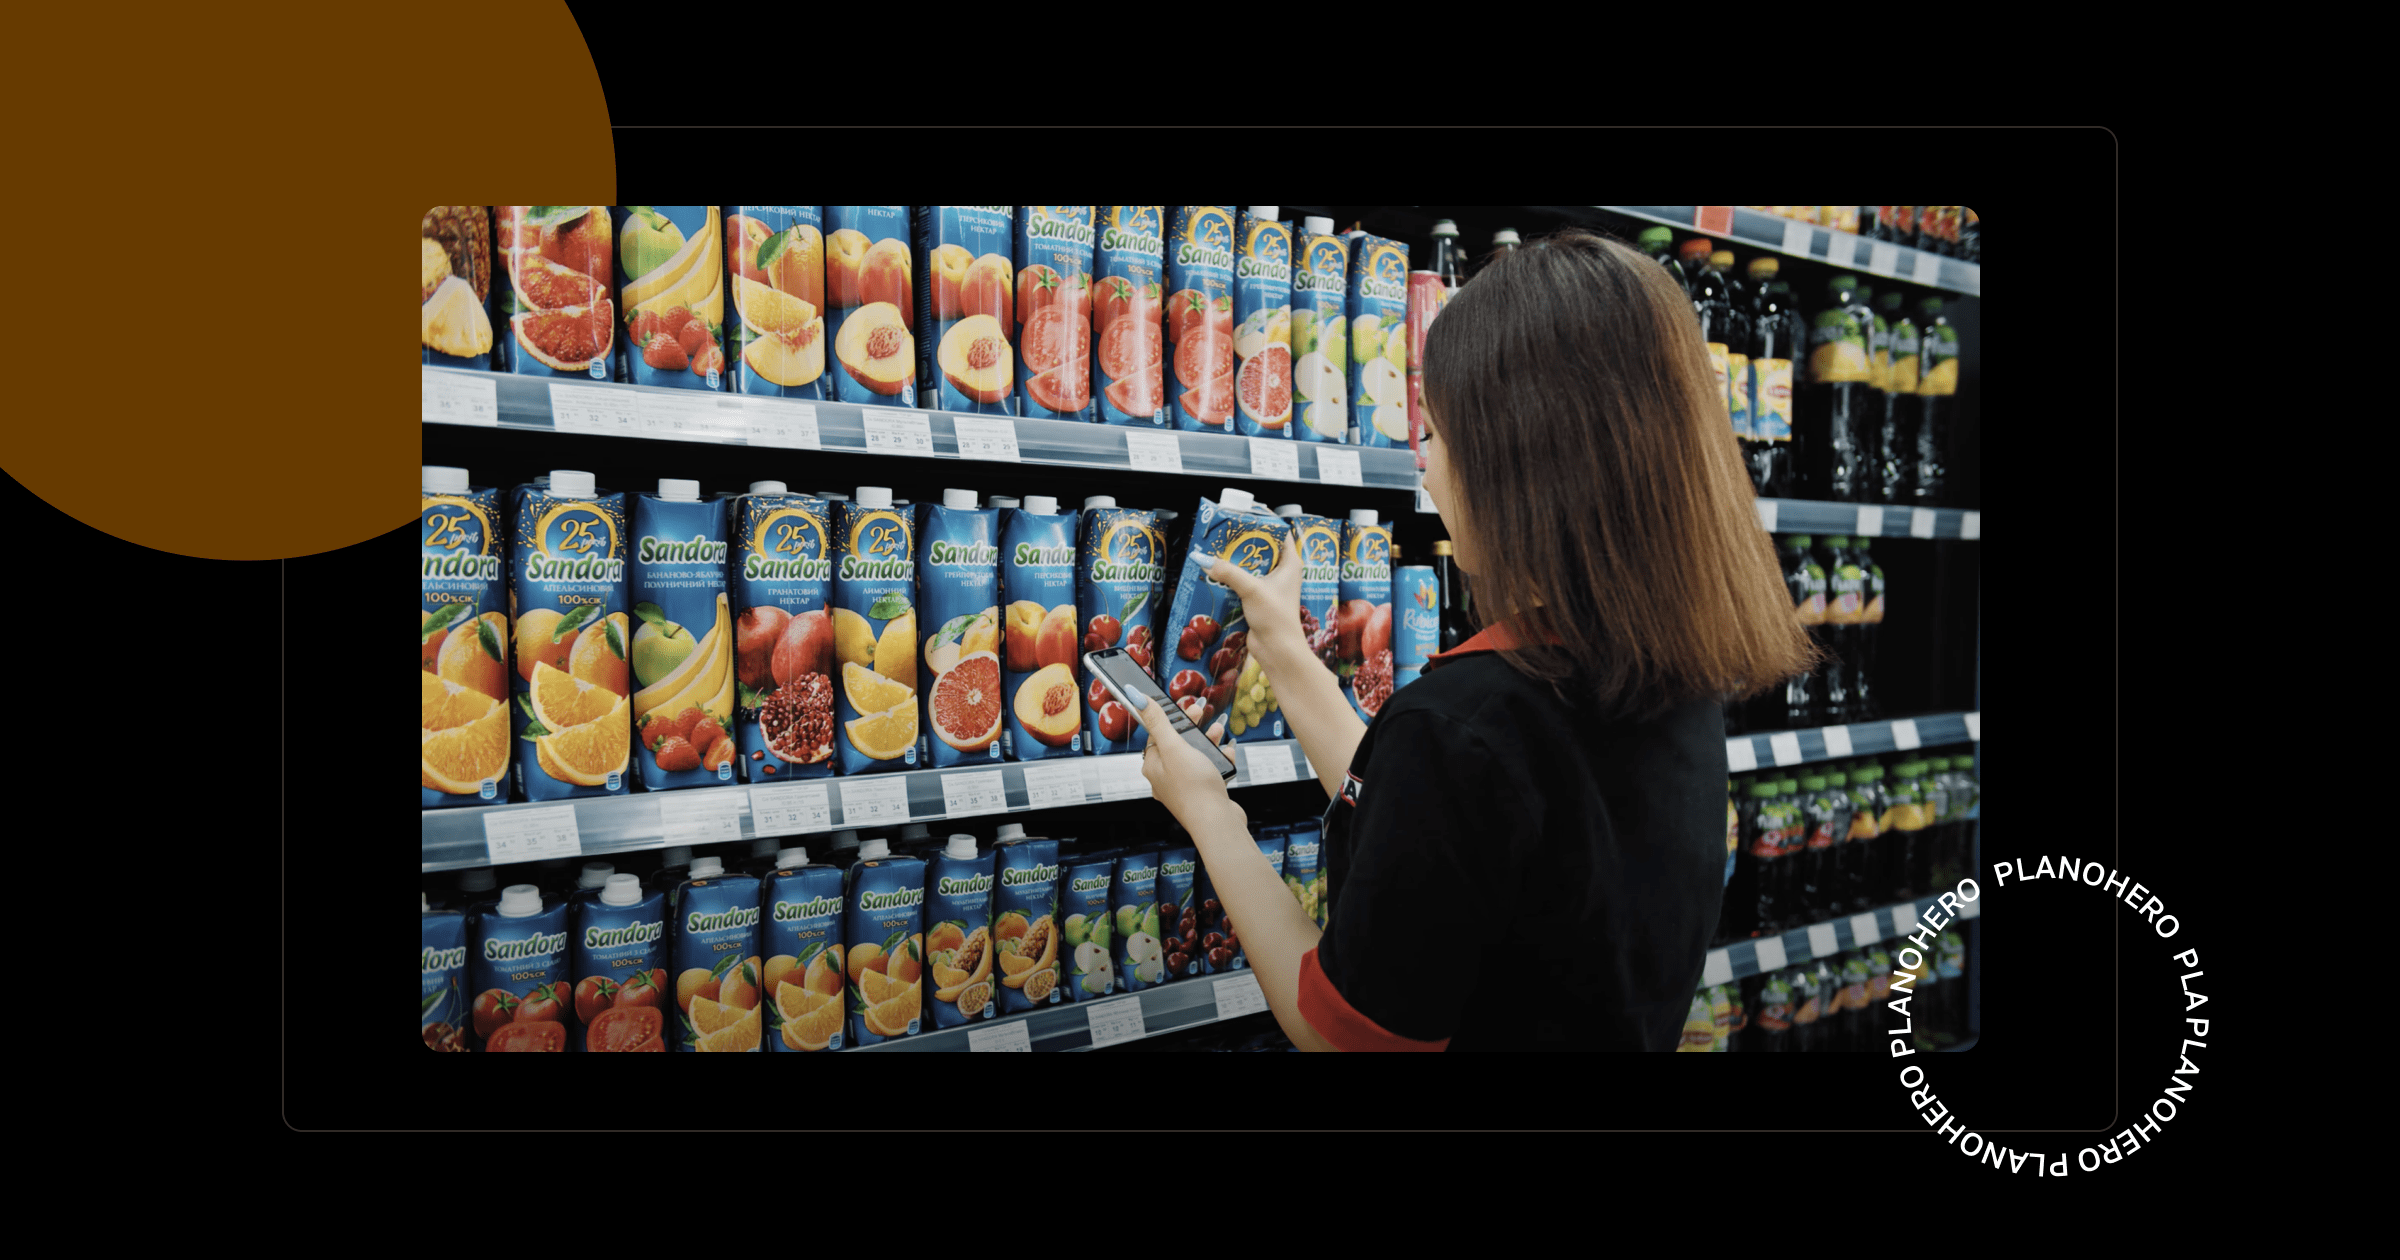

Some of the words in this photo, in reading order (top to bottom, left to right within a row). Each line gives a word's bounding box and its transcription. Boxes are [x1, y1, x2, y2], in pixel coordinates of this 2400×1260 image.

[868, 208, 895, 218] НЕКТАР
[970, 224, 997, 235] НЕКТАР
[1027, 212, 1095, 249] Sandor
[1203, 219, 1226, 246] 25
[1101, 227, 1164, 260] Sandor
[1262, 234, 1283, 259] 25
[1318, 248, 1339, 273] 25
[871, 434, 879, 442] 28
[893, 436, 901, 444] 29
[425, 513, 471, 550] 25
[559, 518, 600, 554] 25
[775, 523, 809, 555] 25
[869, 525, 899, 556] 25
[638, 534, 728, 565] Sandora
[1118, 532, 1143, 560] 25
[1238, 543, 1269, 571] 25
[1310, 537, 1331, 563] 25
[1365, 537, 1385, 561] 25
[422, 547, 499, 581] ndora
[525, 551, 623, 583] Sandora
[743, 553, 831, 582] Sandora
[1091, 557, 1153, 583] Sandor
[422, 581, 489, 590] ЕЛЬСИНОВИЙ
[768, 587, 819, 596] ГРАНАТОВИЙ
[862, 586, 907, 595] ЛИМОННИЙ
[780, 596, 809, 605] НЕКТАР
[870, 805, 878, 813] 32
[1122, 866, 1158, 884] Sandor
[1161, 860, 1195, 876] Sandor
[938, 872, 994, 896] Sandor
[1072, 874, 1111, 892] Sandor
[687, 905, 760, 934] Sandora
[773, 896, 843, 922] Sandora
[484, 931, 567, 961] Sandora
[585, 920, 663, 949] Sandora
